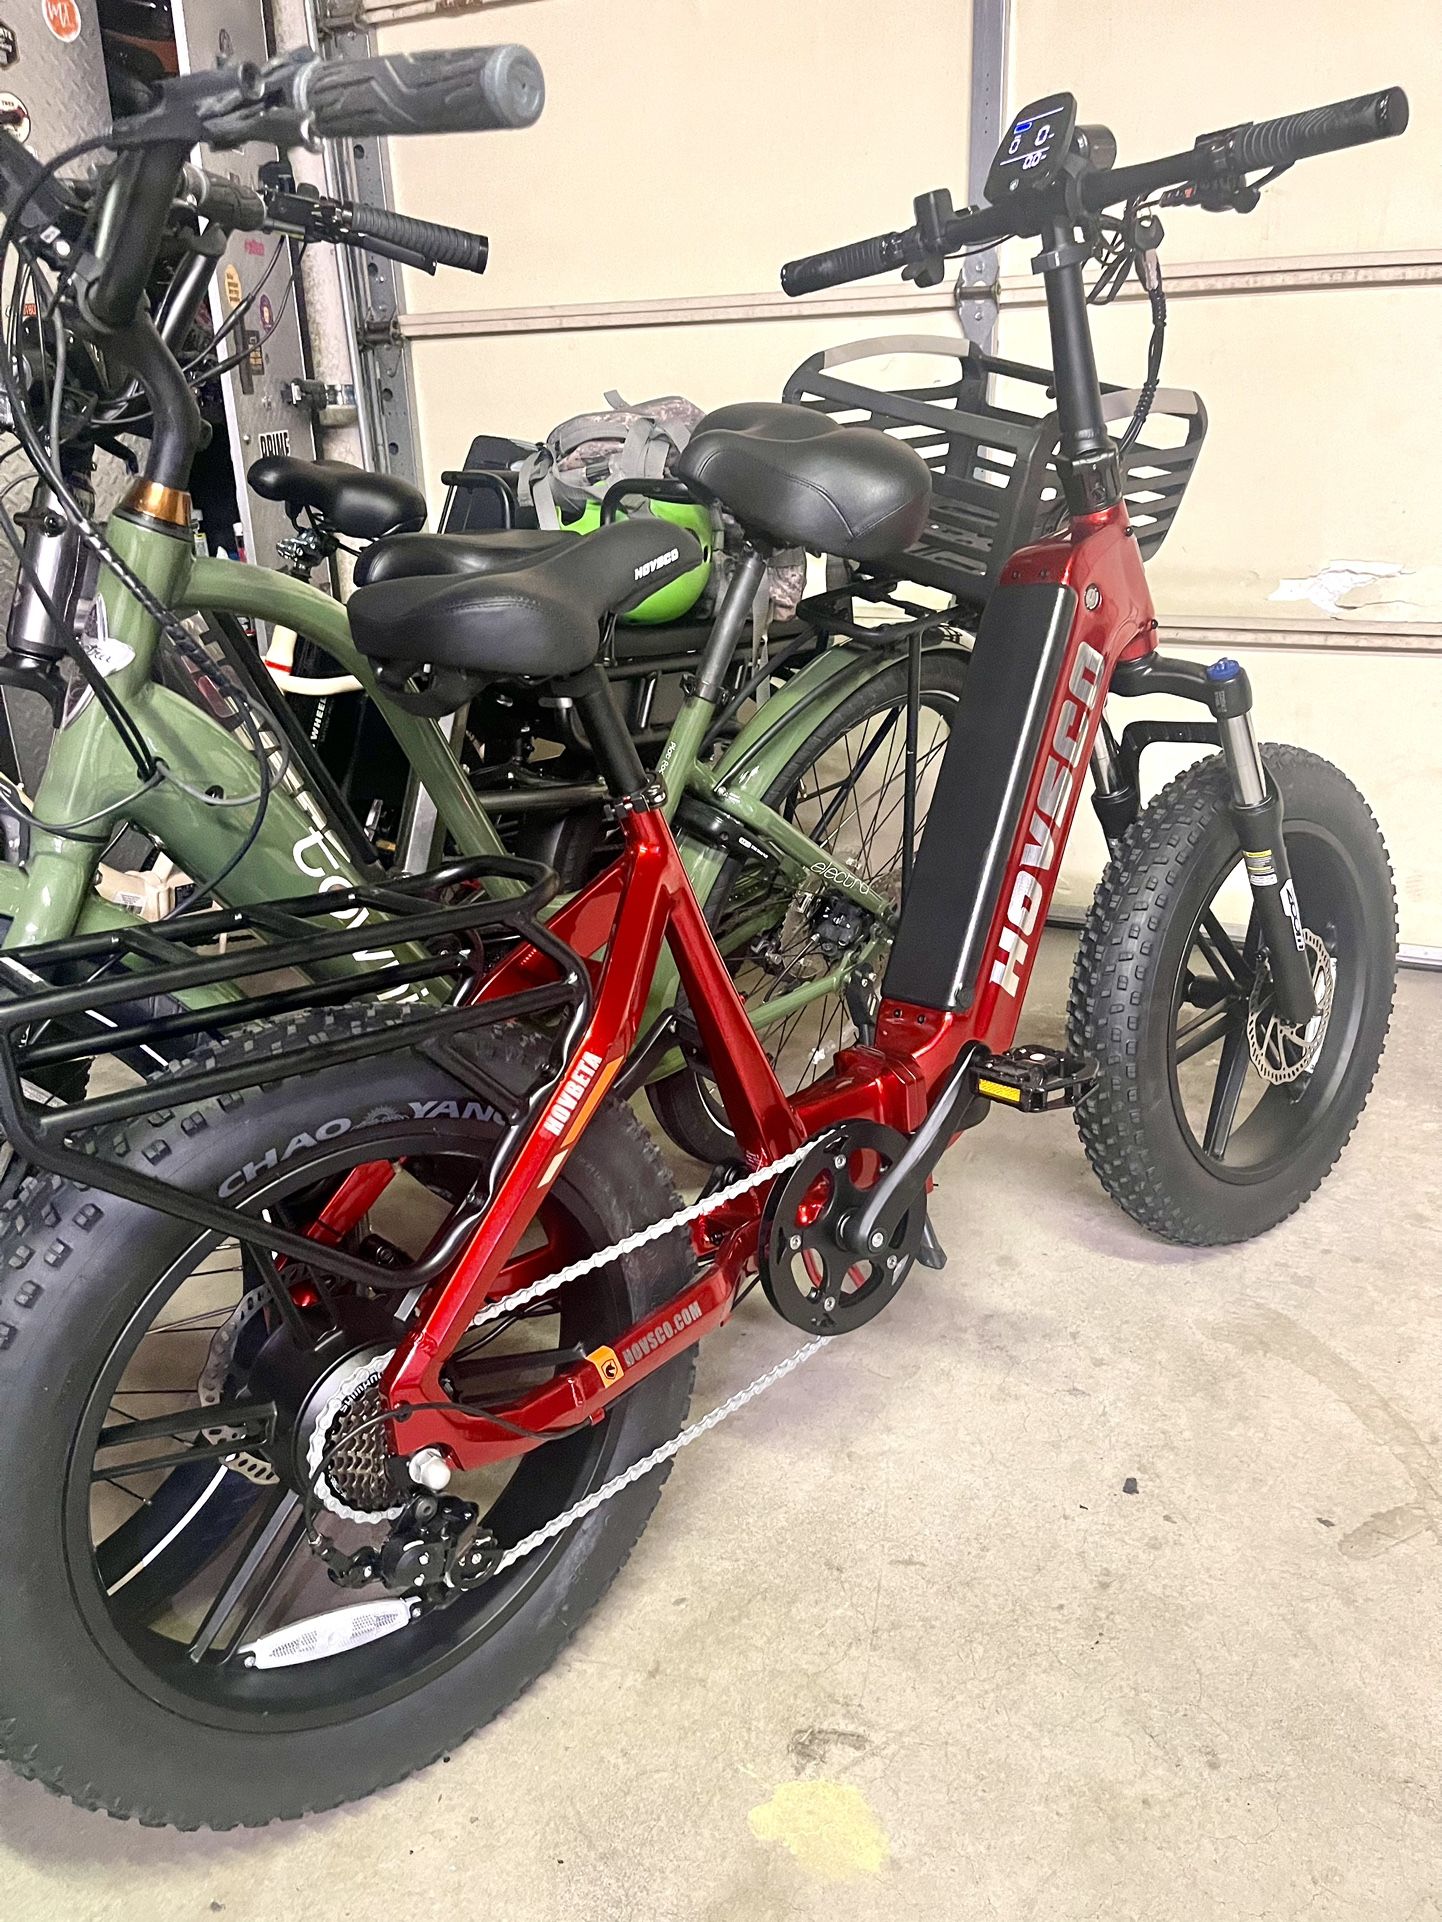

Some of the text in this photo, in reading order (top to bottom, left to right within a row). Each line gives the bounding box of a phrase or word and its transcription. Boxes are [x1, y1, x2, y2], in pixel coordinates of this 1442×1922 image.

[633, 548, 679, 581] HOVSCO
[989, 641, 1105, 998] HOVSCO
[810, 861, 870, 895] electra
[543, 1051, 603, 1137] HOVBETA
[217, 1117, 353, 1198] CHAO
[621, 1299, 703, 1368] HOVSCO.COM
